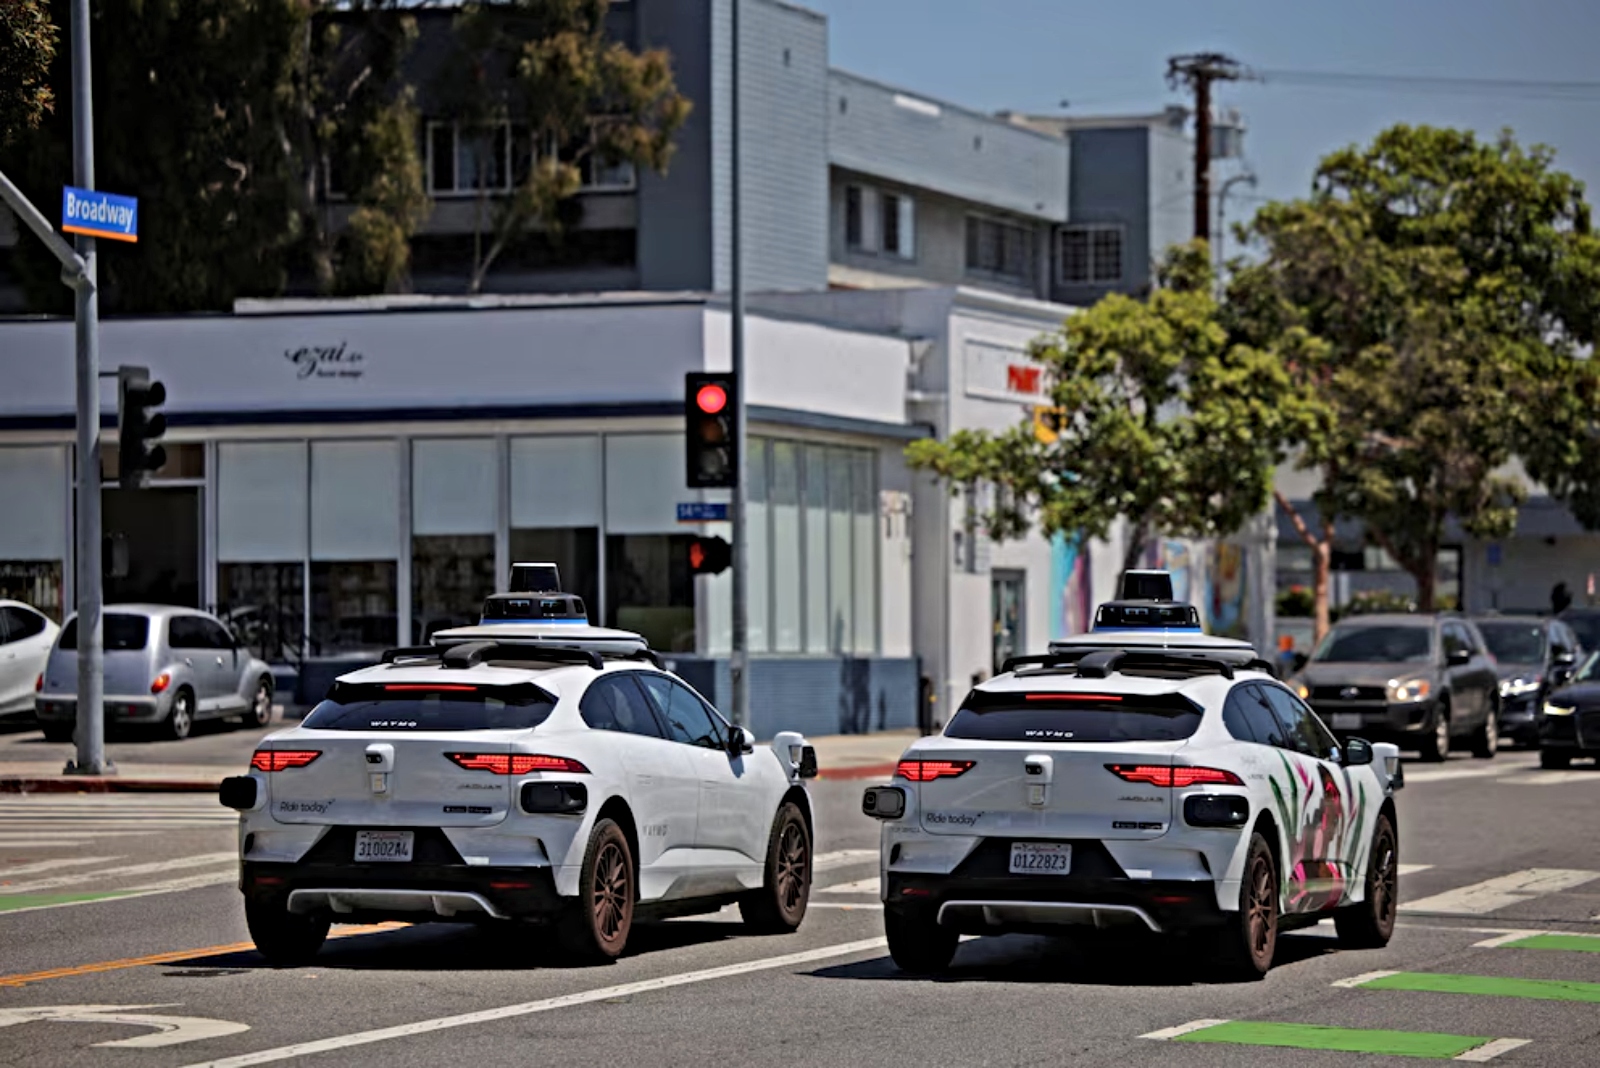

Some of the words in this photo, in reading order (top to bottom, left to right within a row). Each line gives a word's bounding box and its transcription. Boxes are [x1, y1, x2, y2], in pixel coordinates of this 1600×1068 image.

[66, 192, 134, 233] Broadway
[1025, 730, 1074, 738] WAYMO
[280, 801, 299, 812] Ride
[301, 801, 328, 814] today
[926, 812, 947, 824] Ride
[948, 814, 977, 827] today
[358, 841, 409, 856] 31002A4
